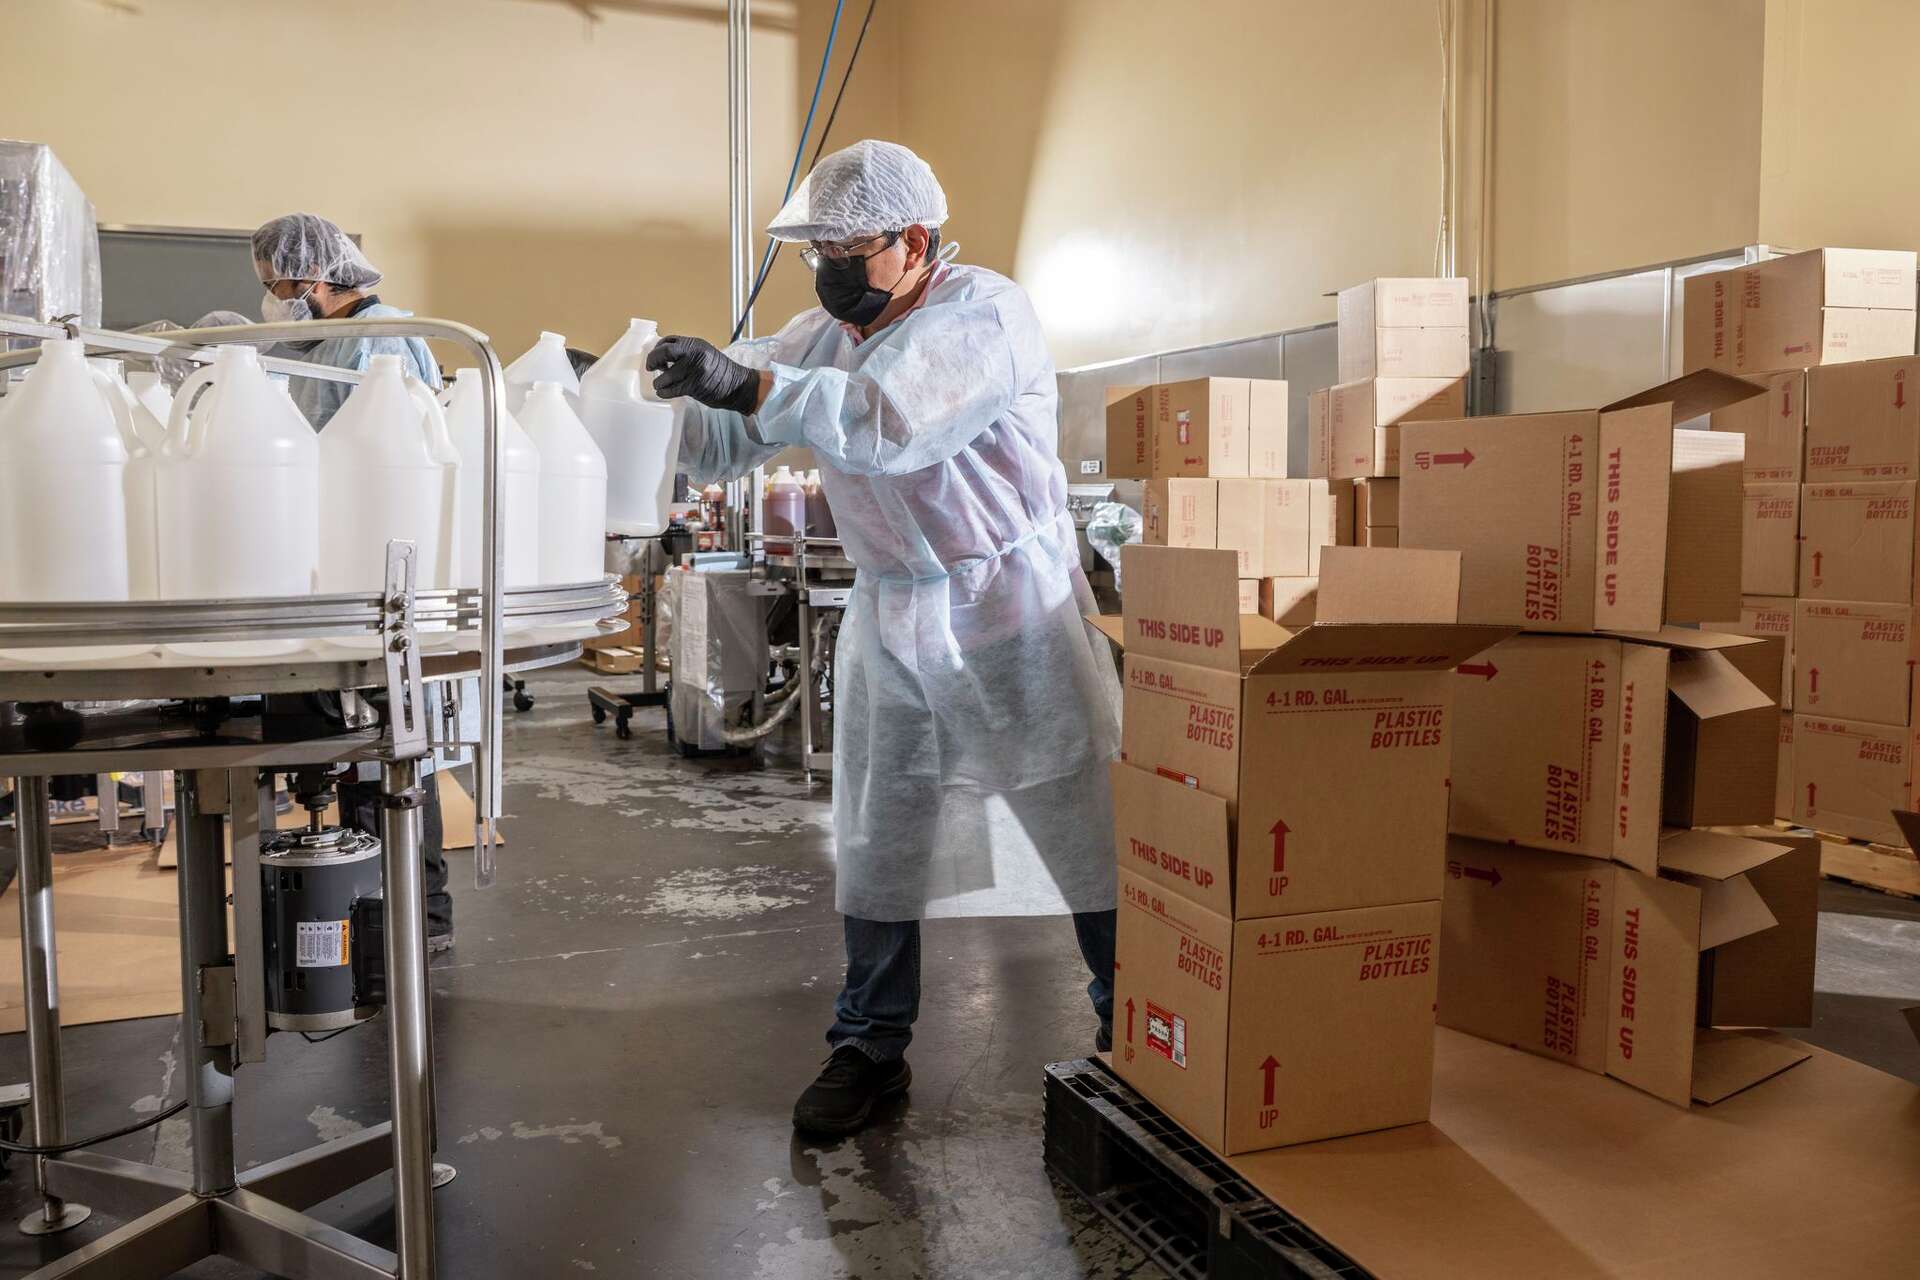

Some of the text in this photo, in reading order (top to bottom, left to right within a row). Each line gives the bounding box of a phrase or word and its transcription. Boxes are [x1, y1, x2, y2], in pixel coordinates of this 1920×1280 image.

[1714, 281, 1724, 359] THIS SIDE UP
[1136, 397, 1145, 465] THIS SIDE UP
[1568, 434, 1583, 459] 4-1
[1809, 445, 1850, 456] BOTTLES
[1414, 451, 1430, 470] UP
[1810, 456, 1849, 466] PLASTIC
[1568, 463, 1582, 488] RD.
[1567, 491, 1581, 525] GAL.
[1756, 510, 1793, 520] BOTTLES
[1757, 501, 1793, 510] PLASTIC
[1866, 510, 1909, 520] BOTTLES
[1867, 498, 1909, 509] PLASTIC
[1604, 448, 1621, 607] THIS SIDE UP
[1525, 544, 1541, 621] BOTTLES
[1542, 547, 1559, 622] PLASTIC
[1754, 622, 1790, 633] BOTTLES
[1756, 612, 1790, 623] PLASTIC
[1863, 621, 1905, 633] PLASTIC
[1138, 618, 1225, 649] THIS SIDE UP
[1861, 631, 1905, 643] BOTTLES
[1300, 655, 1450, 667] THIS SIDE UP
[1591, 660, 1606, 684] 4-1
[1130, 668, 1176, 691] 4-1 RD. GAL.
[1266, 691, 1290, 707] 4-1
[1295, 690, 1319, 706] RD.
[1323, 688, 1354, 705] GAL.
[1590, 688, 1604, 713] RD.
[1189, 704, 1235, 730] PLASTIC
[1375, 710, 1443, 729] PLASTIC
[1187, 724, 1234, 751] BOTTLES
[1371, 729, 1442, 749] BOTTLES
[1588, 717, 1603, 749] GAL.
[1858, 750, 1902, 764] BOTTLES
[1860, 741, 1903, 754] PLASTIC
[1619, 681, 1634, 839] THIS SIDE UP
[1545, 764, 1562, 841] BOTTLES
[1561, 769, 1580, 844] PLASTIC
[1129, 837, 1214, 890] THIS SIDE UP
[1269, 876, 1289, 897] UP
[1587, 879, 1601, 903] 4-1
[1124, 883, 1169, 918] 4-1 RD. GAL.
[1586, 908, 1600, 931] RD.
[1257, 933, 1281, 949] 4-1
[1285, 930, 1309, 947] RD.
[1313, 926, 1345, 943] GAL.
[1180, 936, 1223, 972] PLASTIC
[1364, 939, 1432, 962] PLASTIC
[1584, 935, 1599, 967] GAL.
[1178, 953, 1222, 991] BOTTLES
[1360, 957, 1431, 981] BOTTLES
[1619, 907, 1640, 1061] THIS SIDE UP
[1544, 975, 1561, 1050] BOTTLES
[1559, 980, 1577, 1055] PLASTIC
[1124, 1045, 1135, 1065] UP
[1259, 1108, 1279, 1130] UP
